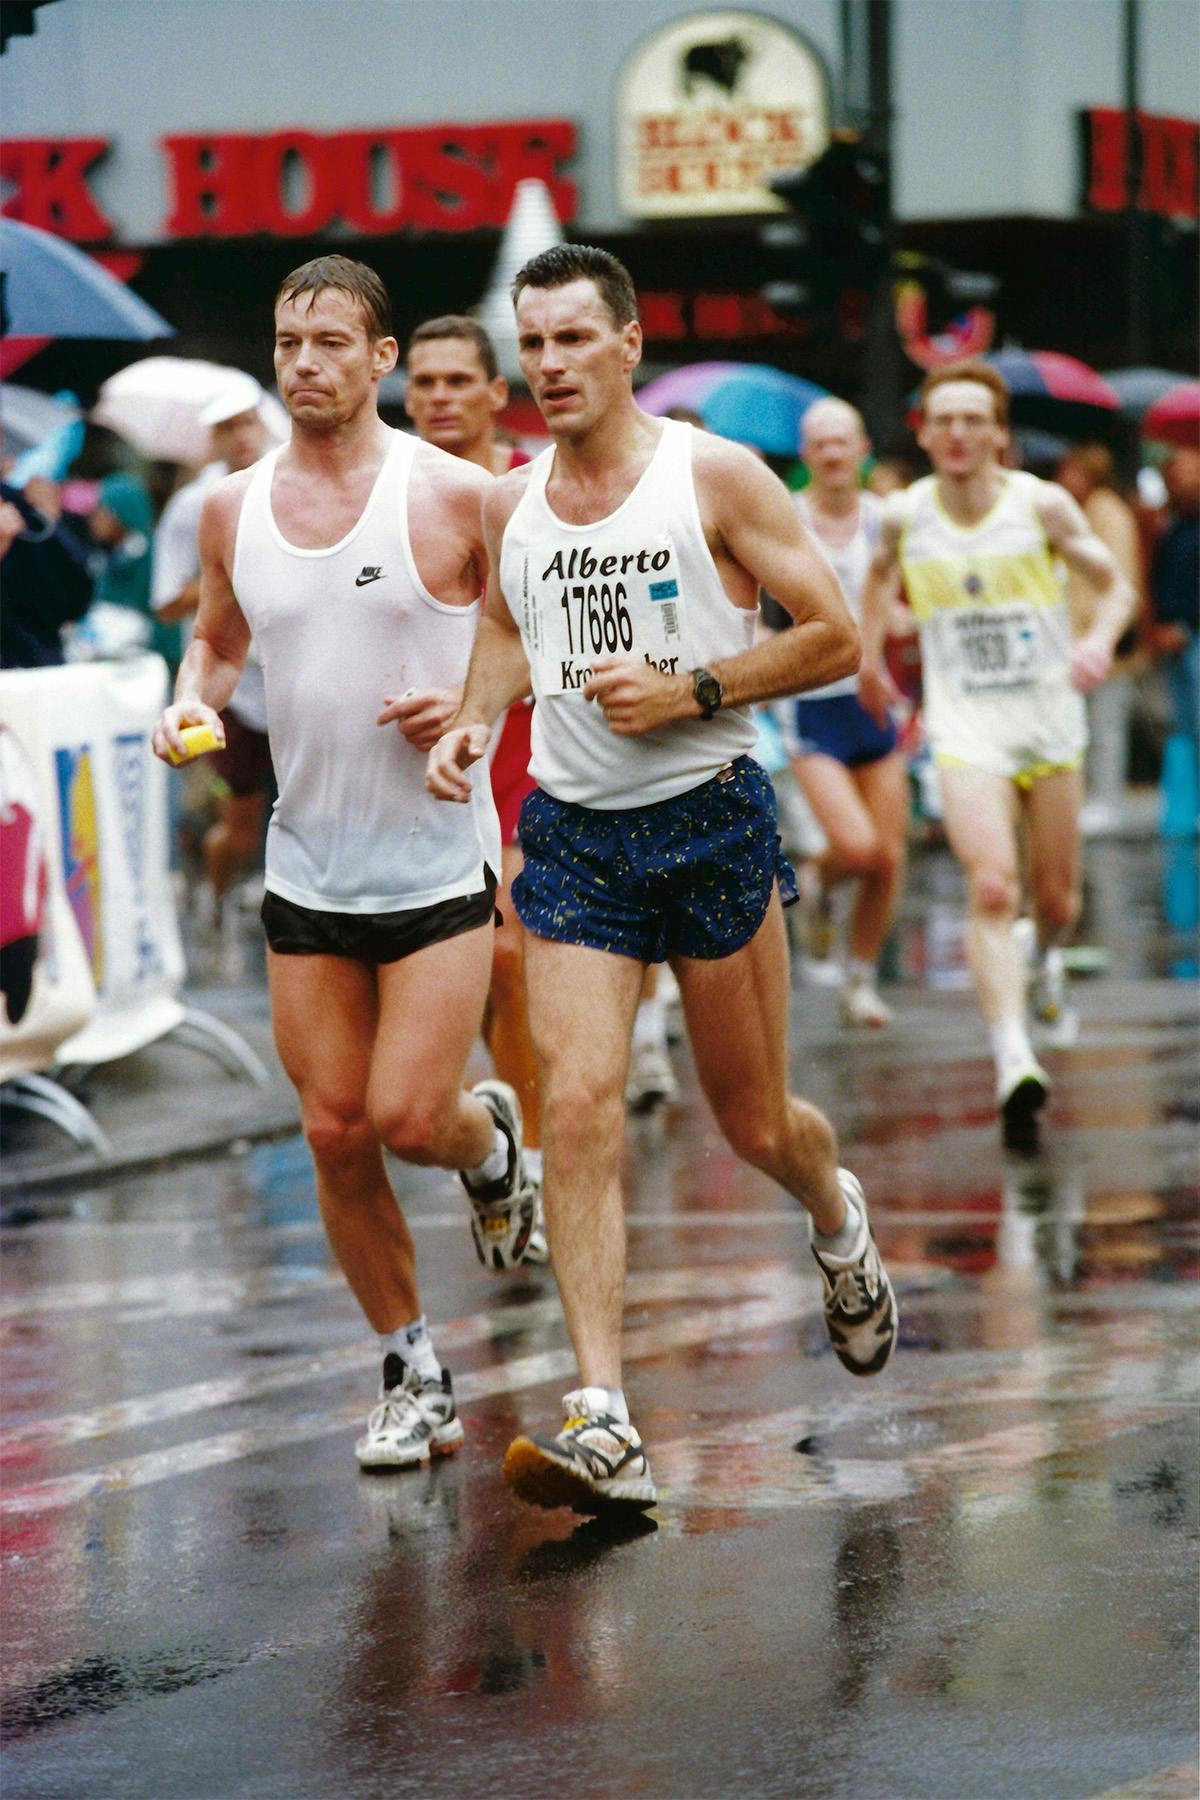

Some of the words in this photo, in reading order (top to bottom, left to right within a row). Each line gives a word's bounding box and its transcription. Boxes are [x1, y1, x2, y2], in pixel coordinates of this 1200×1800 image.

[161, 119, 577, 238] HOUSE
[542, 546, 671, 582] Alberto
[561, 582, 634, 655] 17686
